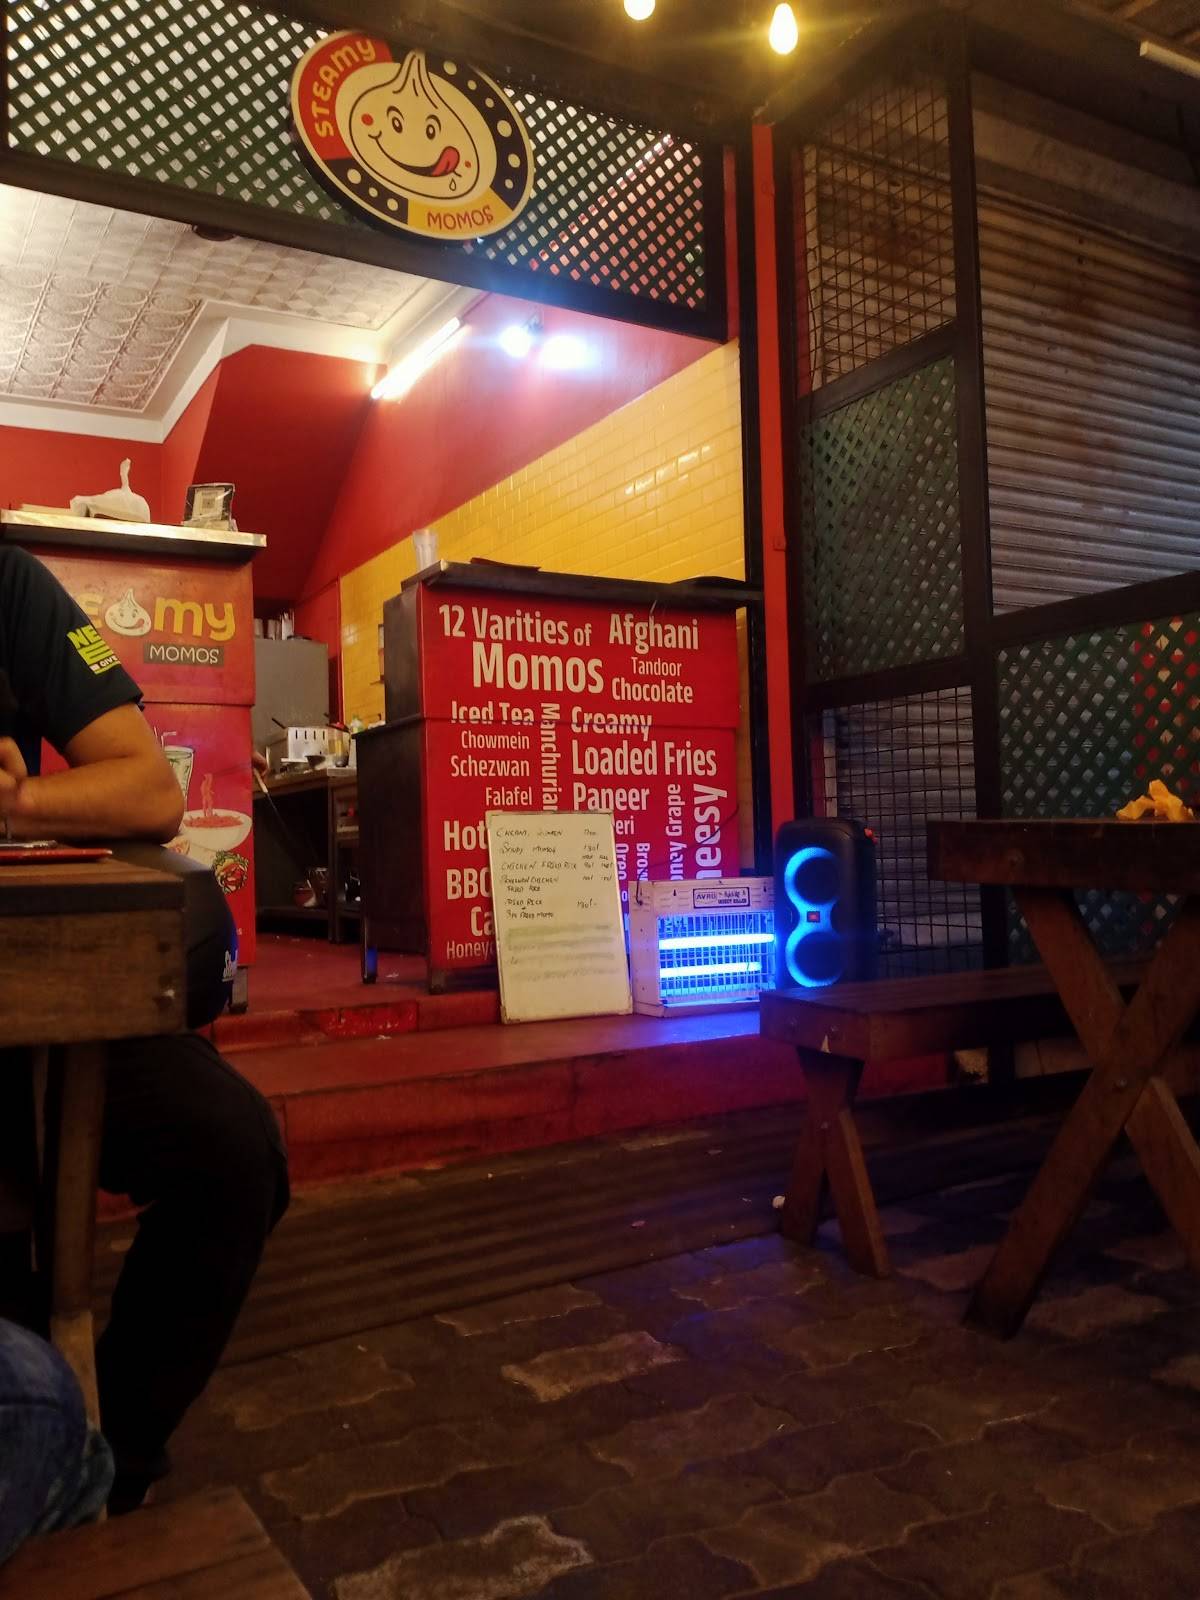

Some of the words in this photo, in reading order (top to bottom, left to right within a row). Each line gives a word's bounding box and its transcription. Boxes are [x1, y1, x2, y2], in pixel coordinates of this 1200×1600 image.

[427, 204, 494, 230] MOMOS
[438, 604, 466, 638] 12
[471, 606, 570, 646] Varities
[573, 623, 593, 647] of
[608, 613, 699, 655] Afghani
[149, 644, 219, 665] MOMOS
[472, 641, 604, 694] Momos
[630, 656, 682, 677] Tandoor
[611, 677, 694, 704] Chocolate
[451, 700, 494, 725] Iced
[498, 702, 535, 726] Tea
[571, 706, 653, 742] Creamy
[461, 730, 531, 750] Chowmein
[450, 754, 531, 778] Schezwan
[571, 739, 658, 776] Loaded
[664, 741, 717, 776] Fries
[485, 786, 533, 806] Falafel
[572, 781, 650, 812] Paneer
[665, 783, 685, 837] Grape
[443, 820, 489, 851] Hot
